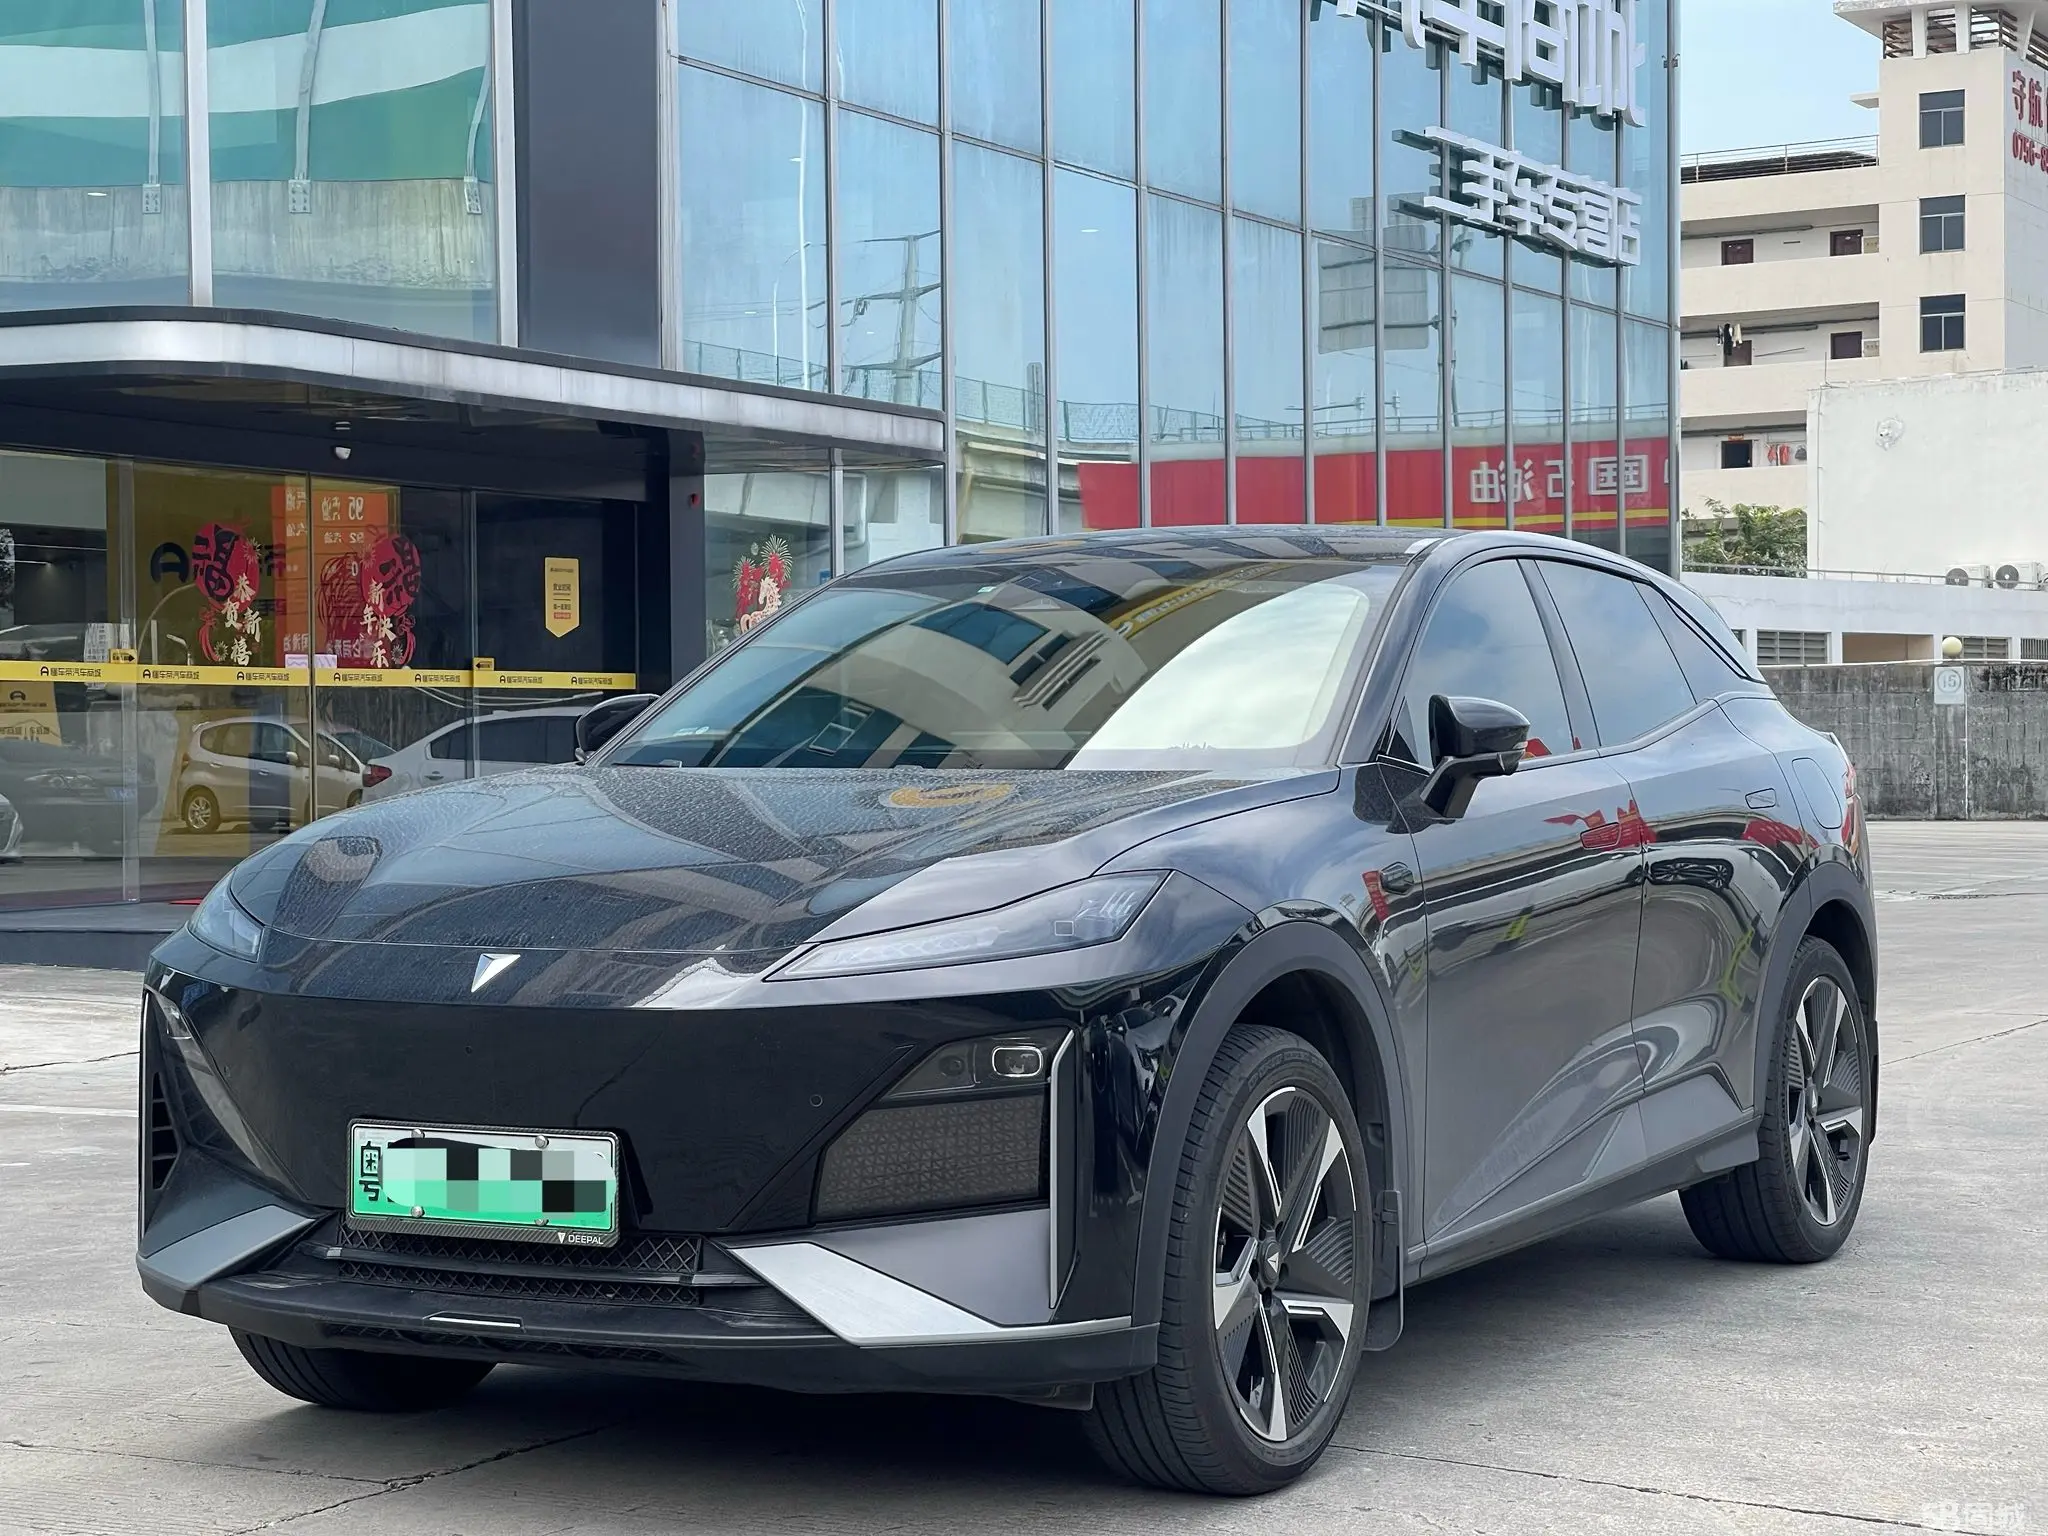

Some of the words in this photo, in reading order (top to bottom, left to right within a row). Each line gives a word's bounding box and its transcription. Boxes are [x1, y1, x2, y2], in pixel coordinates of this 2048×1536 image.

[2012, 131, 2048, 174] 0756-8
[360, 579, 397, 668] 新年快乐
[568, 1234, 604, 1244] DEEPAL
